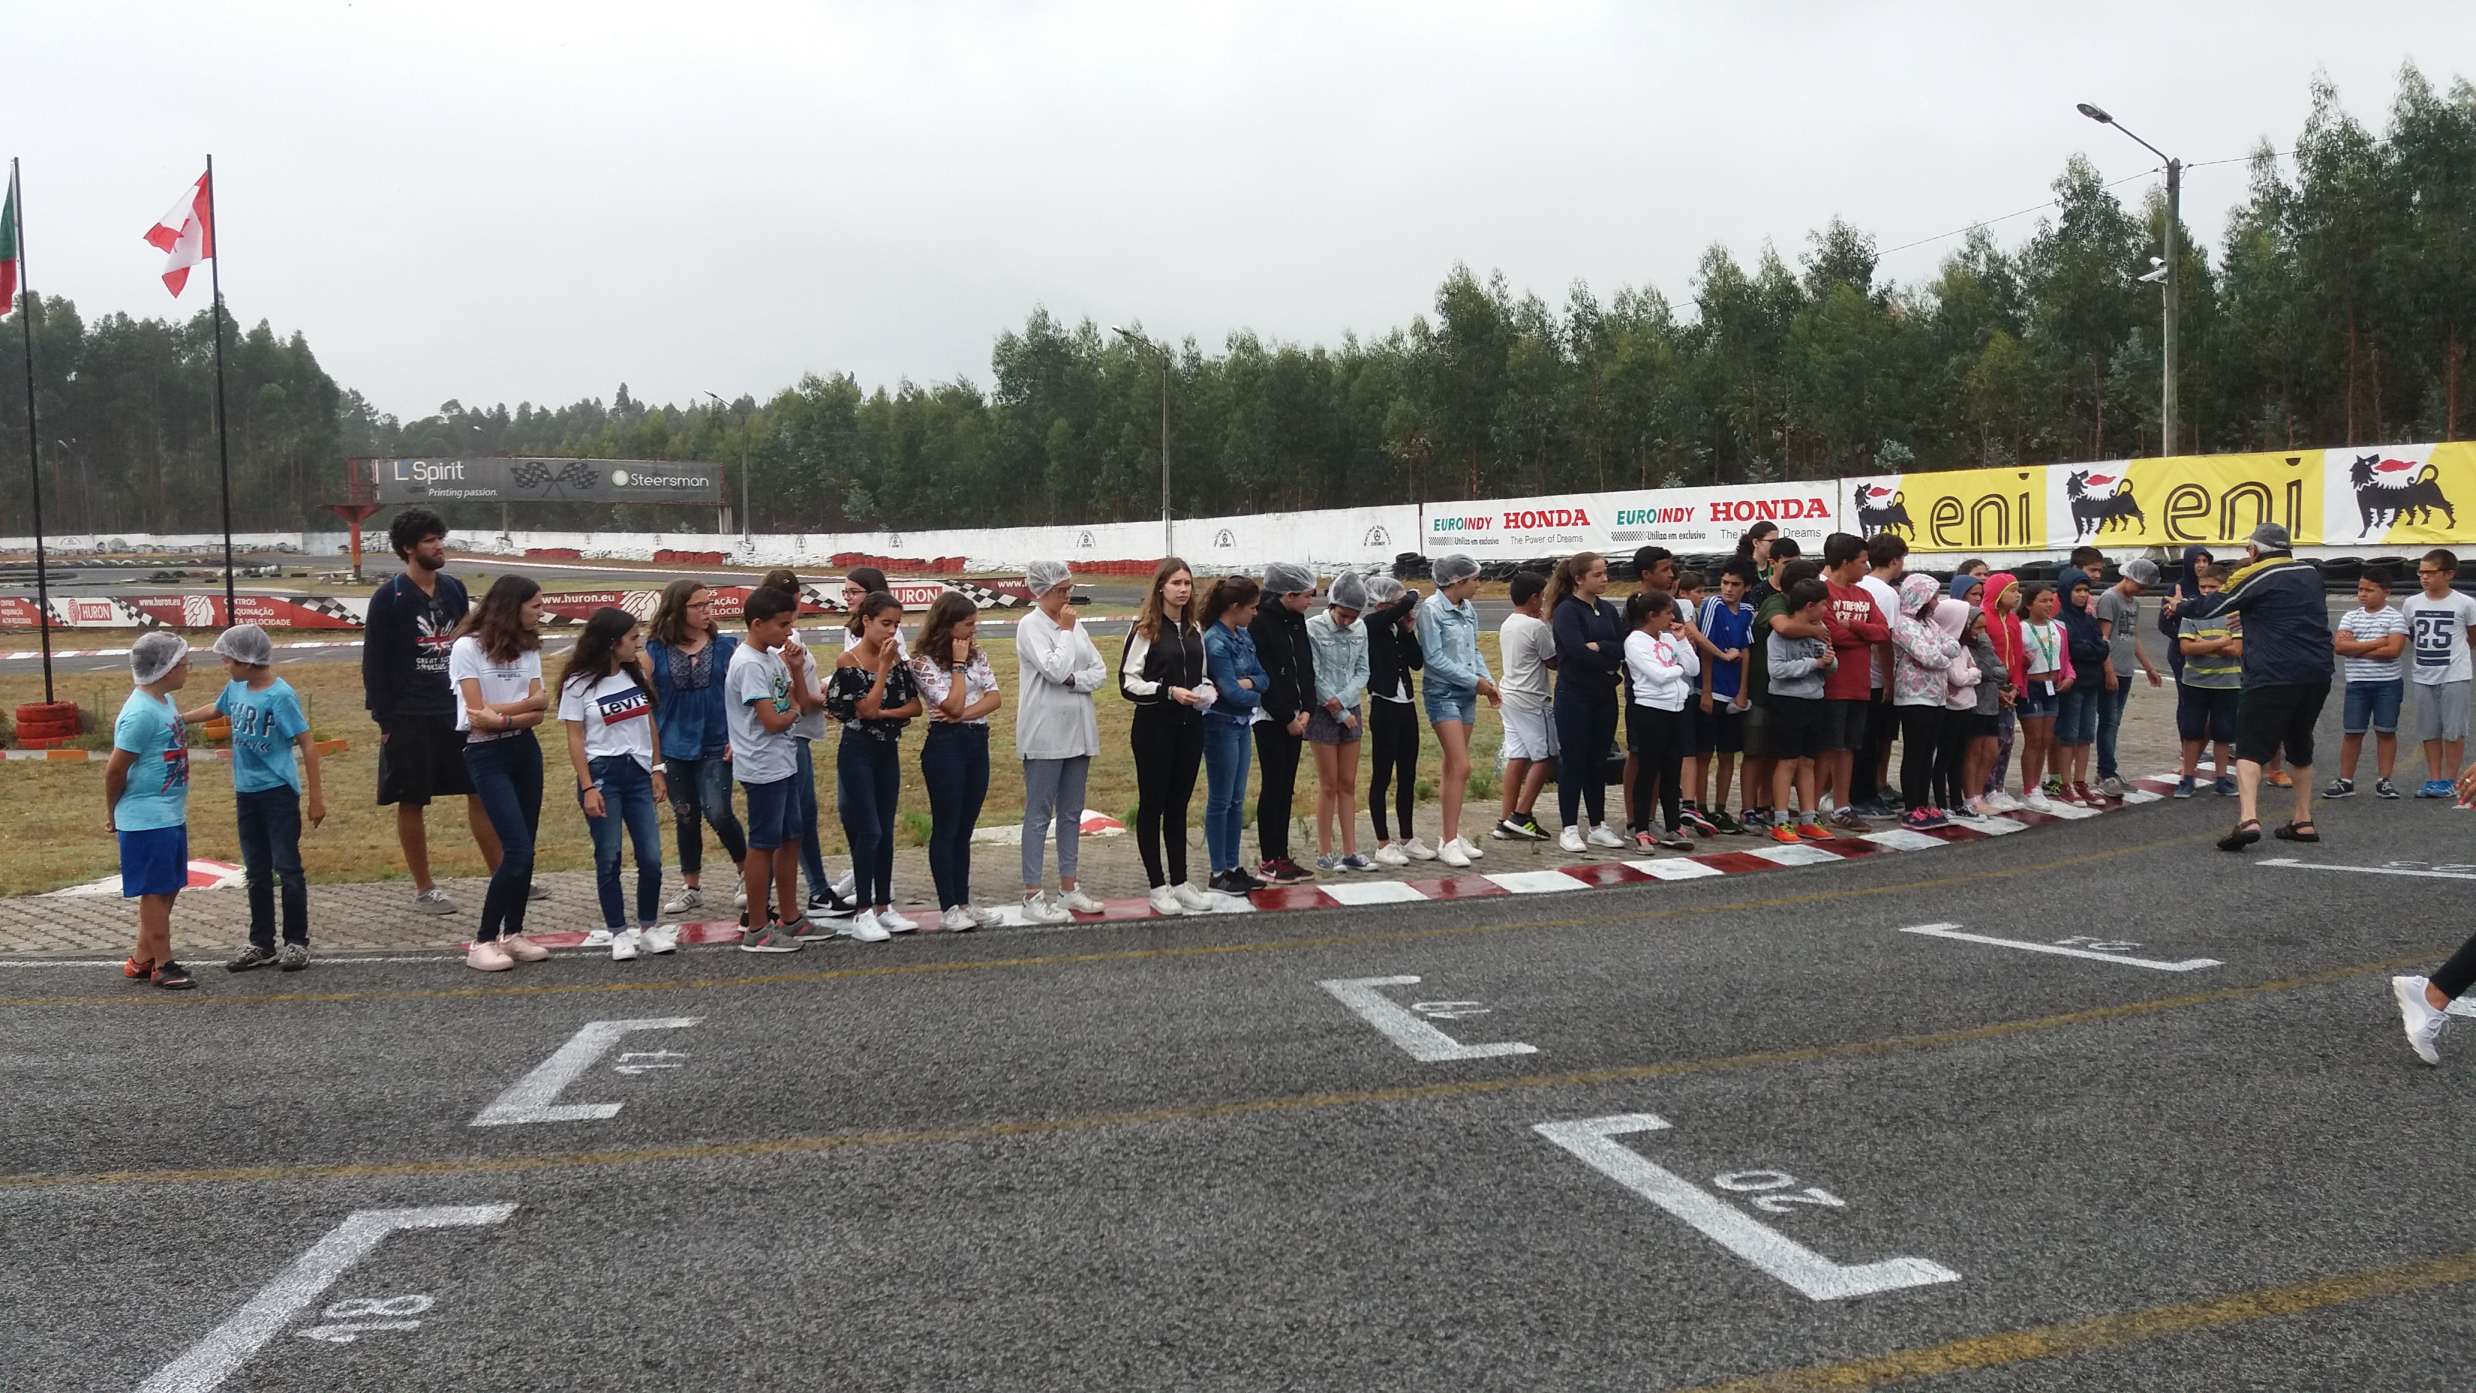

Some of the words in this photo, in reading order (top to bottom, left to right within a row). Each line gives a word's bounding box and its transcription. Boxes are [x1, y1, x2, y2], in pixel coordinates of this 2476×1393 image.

[412, 460, 465, 485] Spirit
[630, 473, 710, 487] Steersman
[428, 488, 463, 499] Printing
[464, 488, 498, 499] passion.
[2164, 458, 2302, 541] eni
[1617, 507, 1695, 526] EUROINDY
[1710, 498, 1831, 522] HONDA
[1930, 473, 2031, 547] eni
[1433, 517, 1493, 531] EUROINDY
[1503, 509, 1591, 529] HONDA
[1511, 536, 1523, 545] The
[1524, 535, 1546, 544] Power
[1547, 534, 1555, 543] of
[1556, 533, 1584, 543] Dreams
[1647, 531, 1667, 540] Utiliza
[1678, 530, 1707, 540] exclusivo
[1720, 529, 1739, 539] The
[1783, 527, 1822, 538] Dreams
[542, 593, 615, 604] ww.huron.eu
[82, 606, 111, 619] HURON
[2416, 619, 2455, 649] 25
